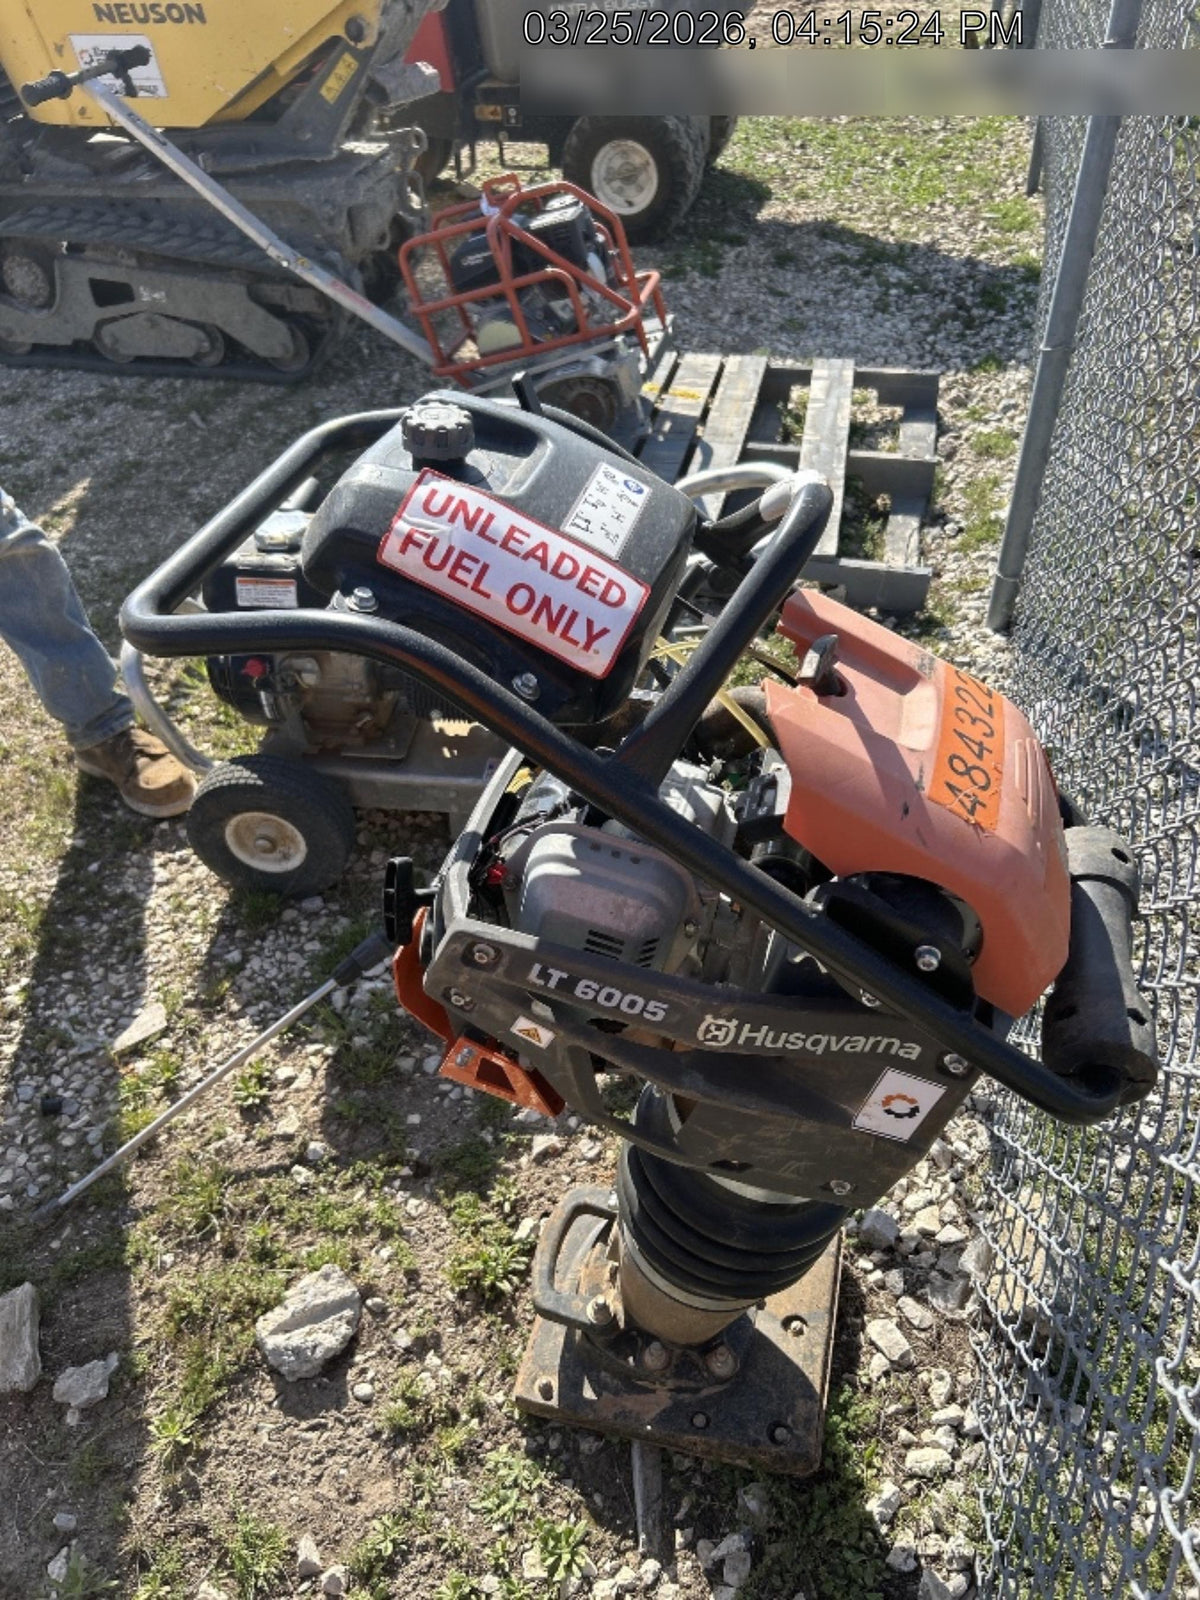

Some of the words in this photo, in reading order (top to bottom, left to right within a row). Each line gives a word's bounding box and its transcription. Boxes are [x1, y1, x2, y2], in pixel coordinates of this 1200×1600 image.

[92, 3, 207, 24] NEUSON
[422, 488, 627, 609] UNLEADED
[398, 528, 492, 600] FUEL
[505, 582, 611, 653] ONLY
[527, 963, 569, 989] LT
[574, 979, 669, 1022] 6005
[737, 1023, 922, 1061] Husqvarna
